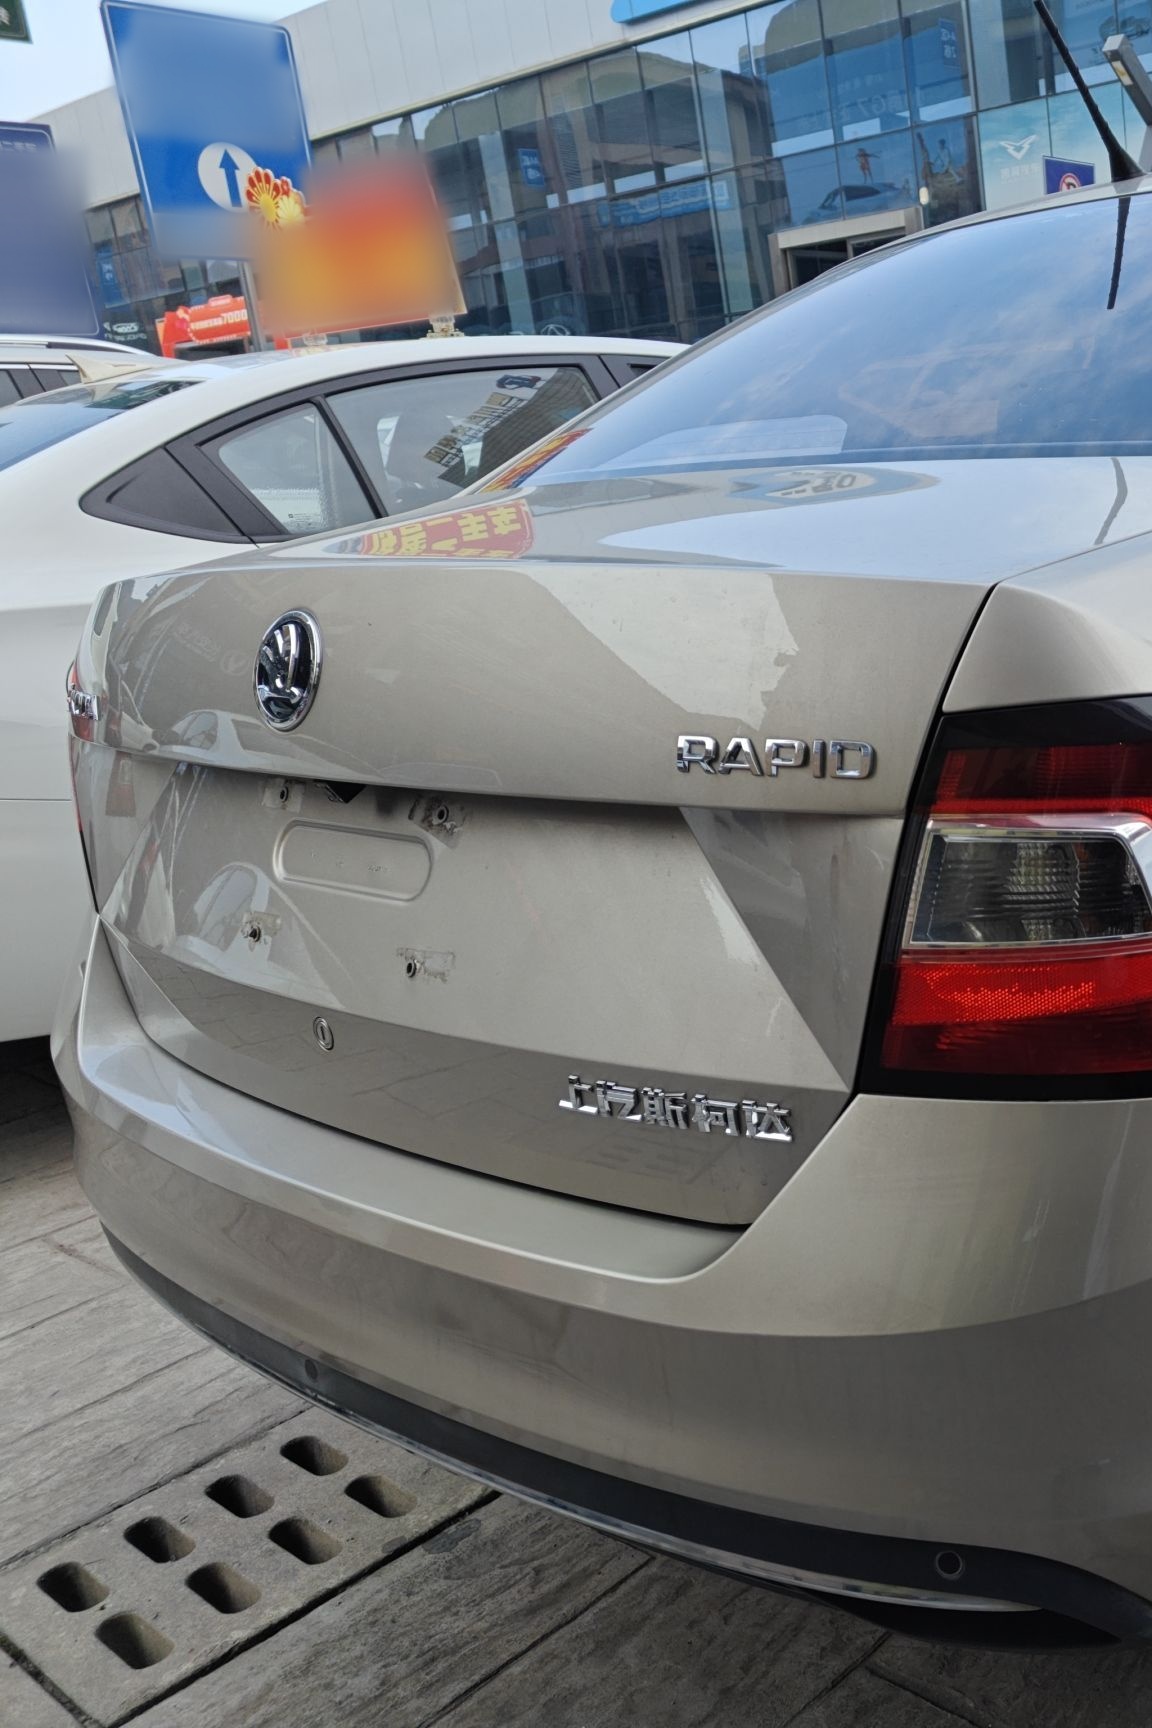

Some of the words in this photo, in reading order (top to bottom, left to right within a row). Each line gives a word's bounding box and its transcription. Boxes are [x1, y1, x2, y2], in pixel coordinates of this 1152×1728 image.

[676, 734, 876, 780] RAPID
[558, 1074, 794, 1143] 上汽斯柯达
